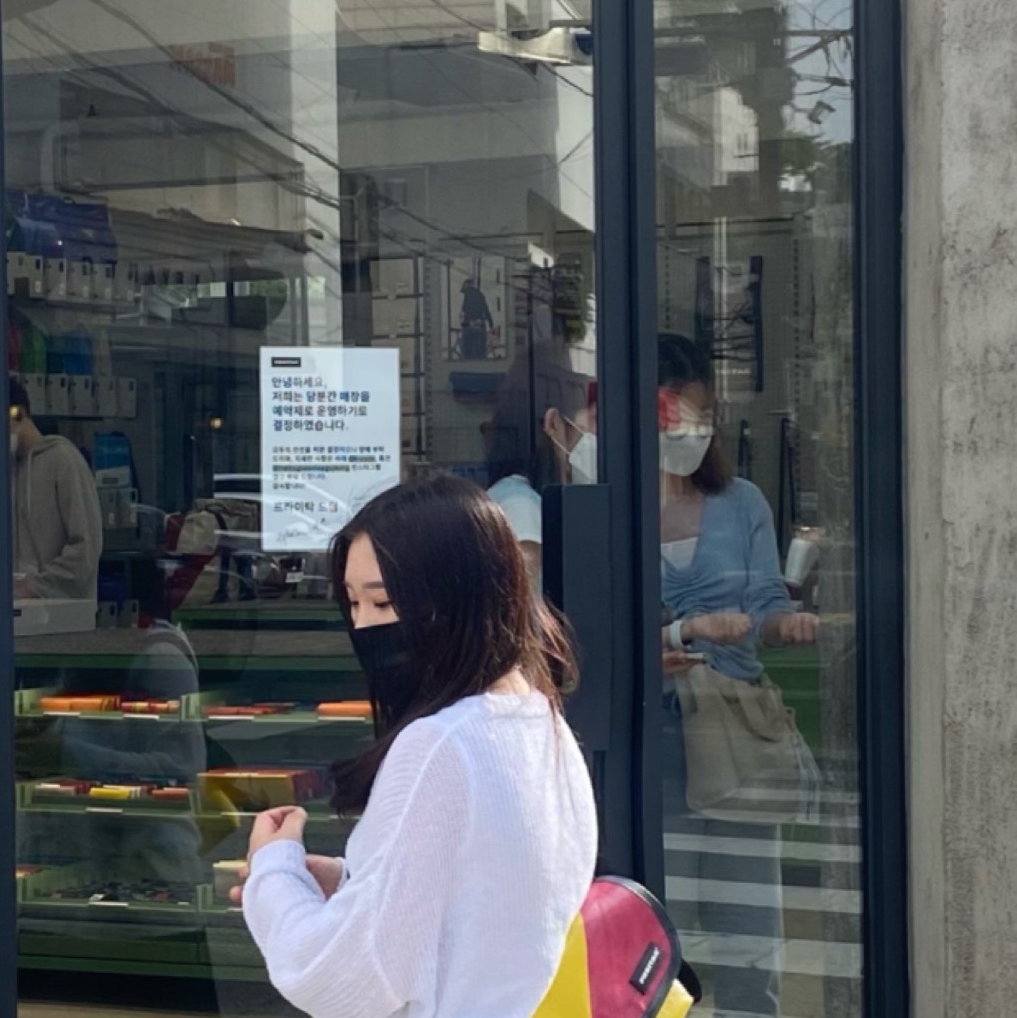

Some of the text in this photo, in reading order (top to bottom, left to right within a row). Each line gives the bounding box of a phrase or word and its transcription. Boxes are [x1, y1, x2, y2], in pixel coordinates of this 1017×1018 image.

[271, 376, 327, 389] 안녕하세요,
[272, 391, 303, 402] 저희는
[340, 391, 370, 402] 매장을
[272, 405, 314, 417] 예약제로
